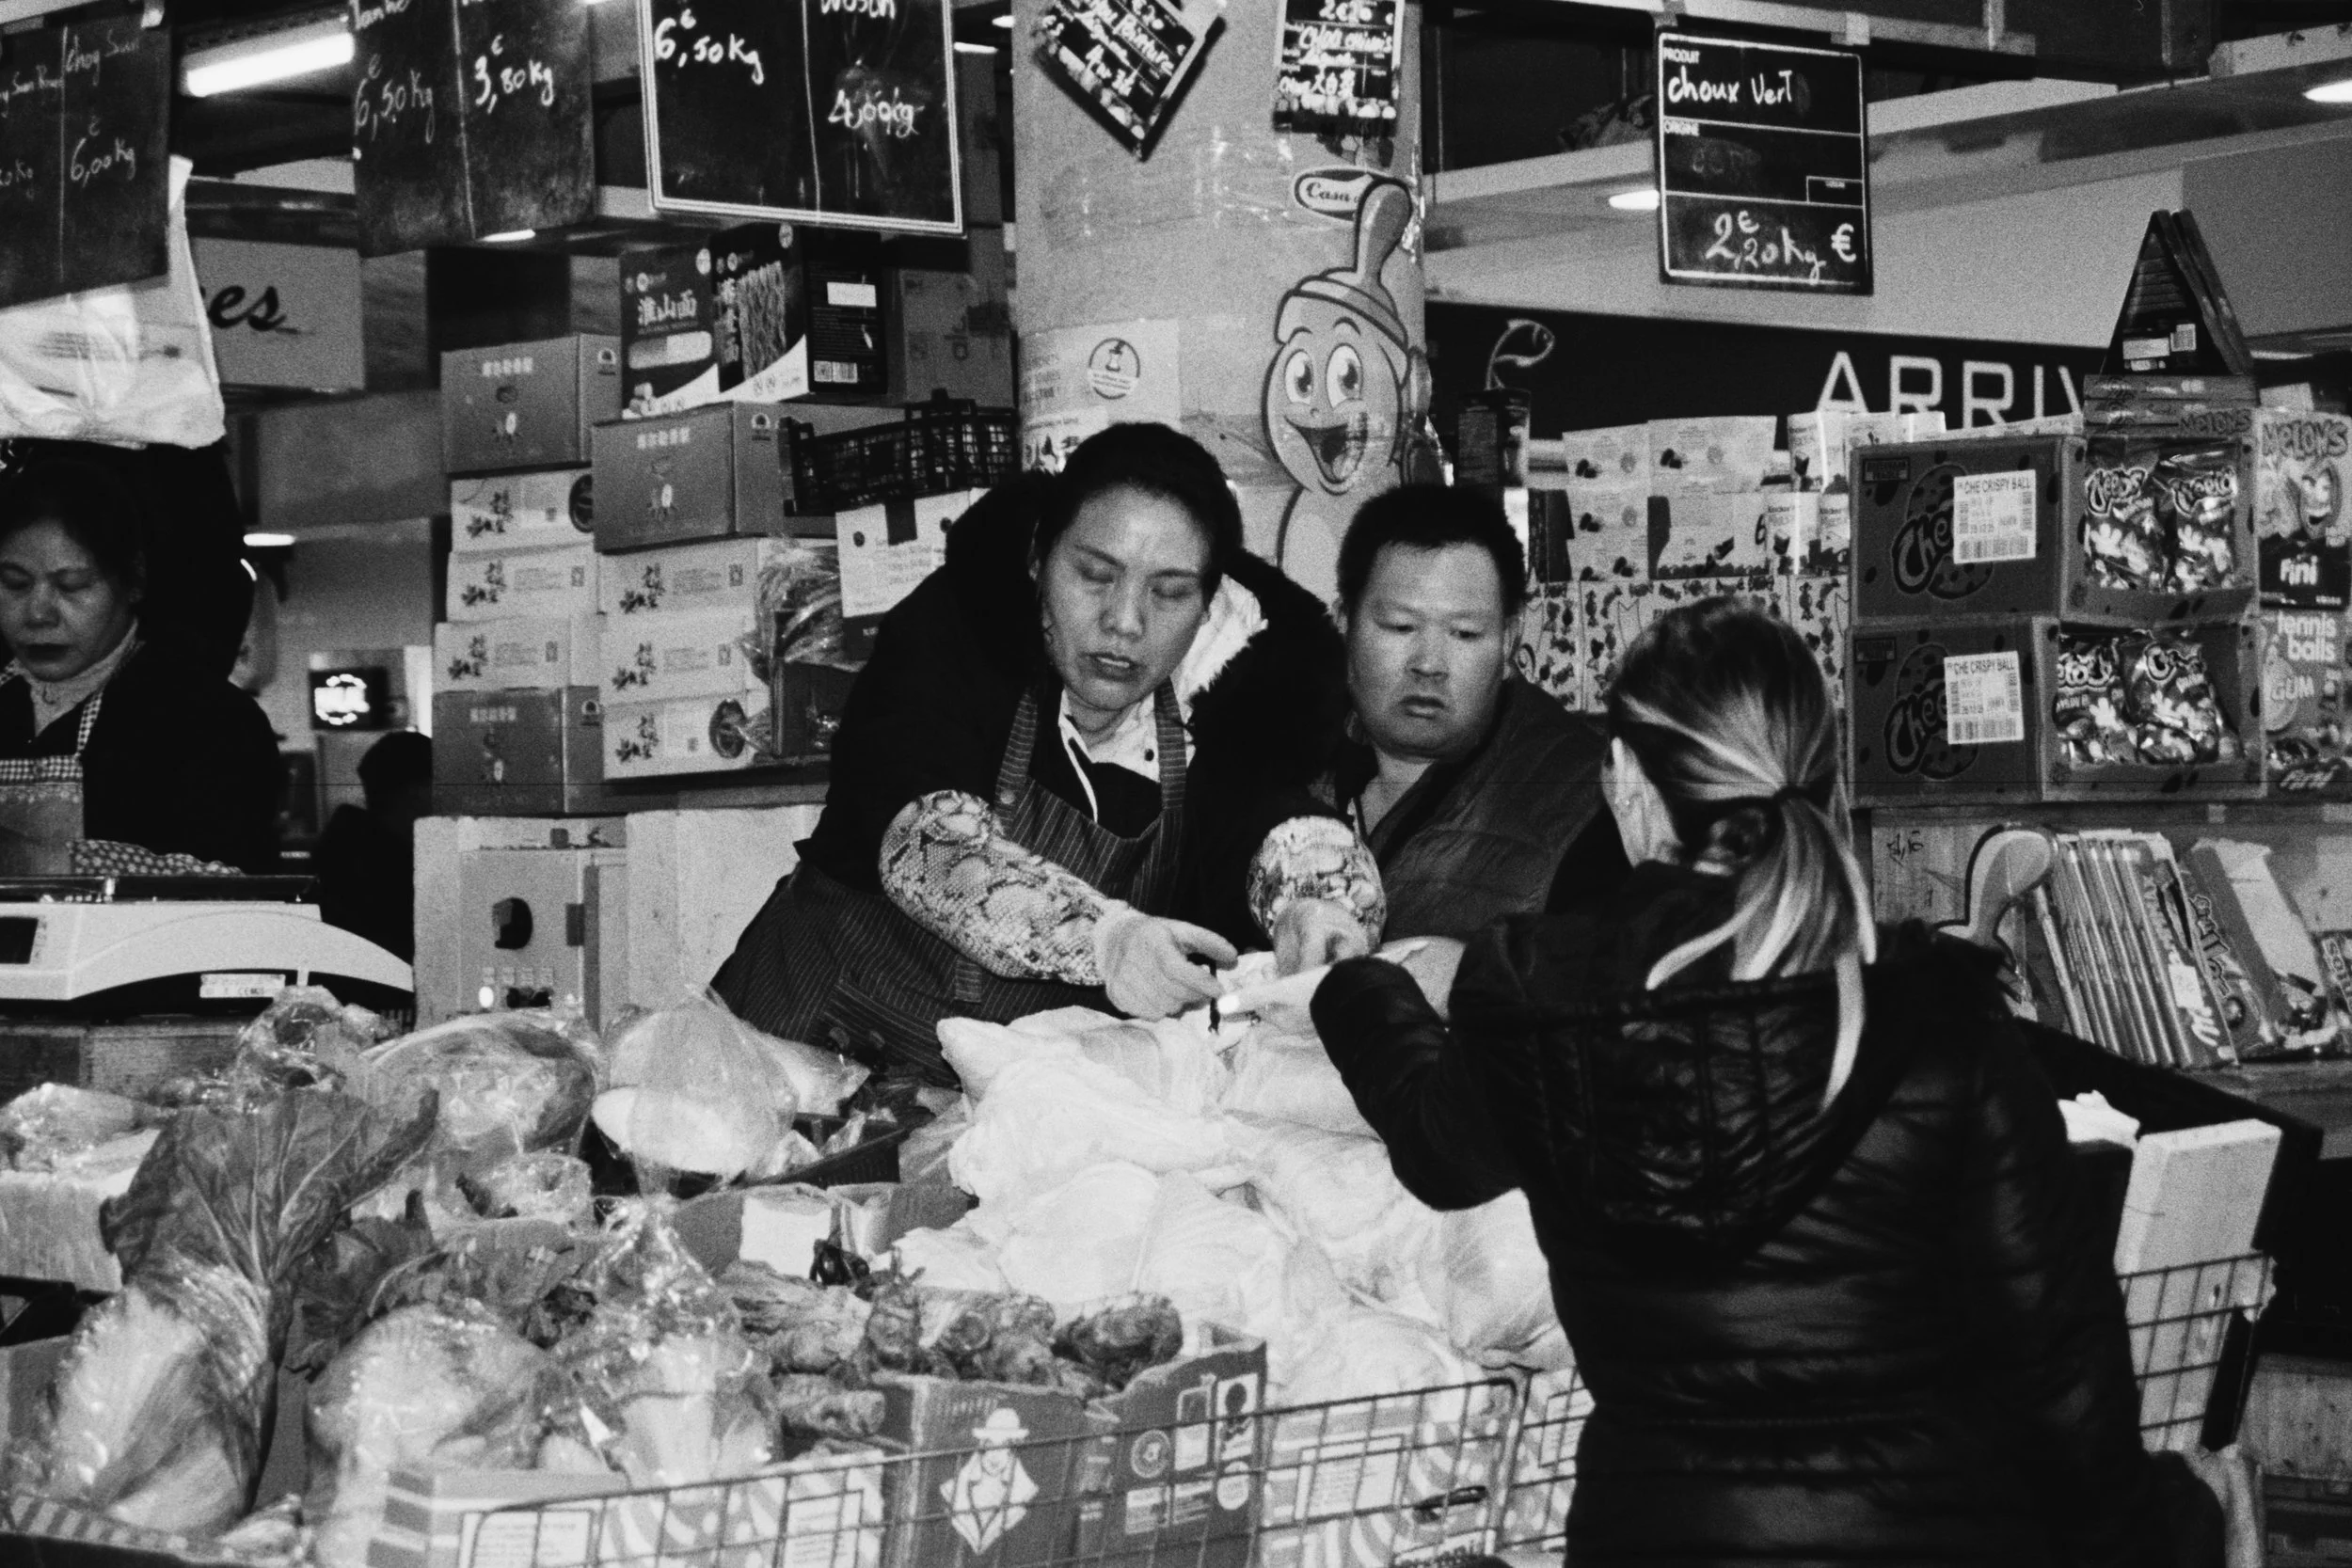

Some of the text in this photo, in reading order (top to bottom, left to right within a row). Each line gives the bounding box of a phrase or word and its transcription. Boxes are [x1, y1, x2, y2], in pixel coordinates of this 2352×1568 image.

[199, 284, 288, 333] es
[2277, 611, 2338, 638] tennis
[2287, 634, 2337, 663] balls
[2271, 675, 2315, 701] GUM
